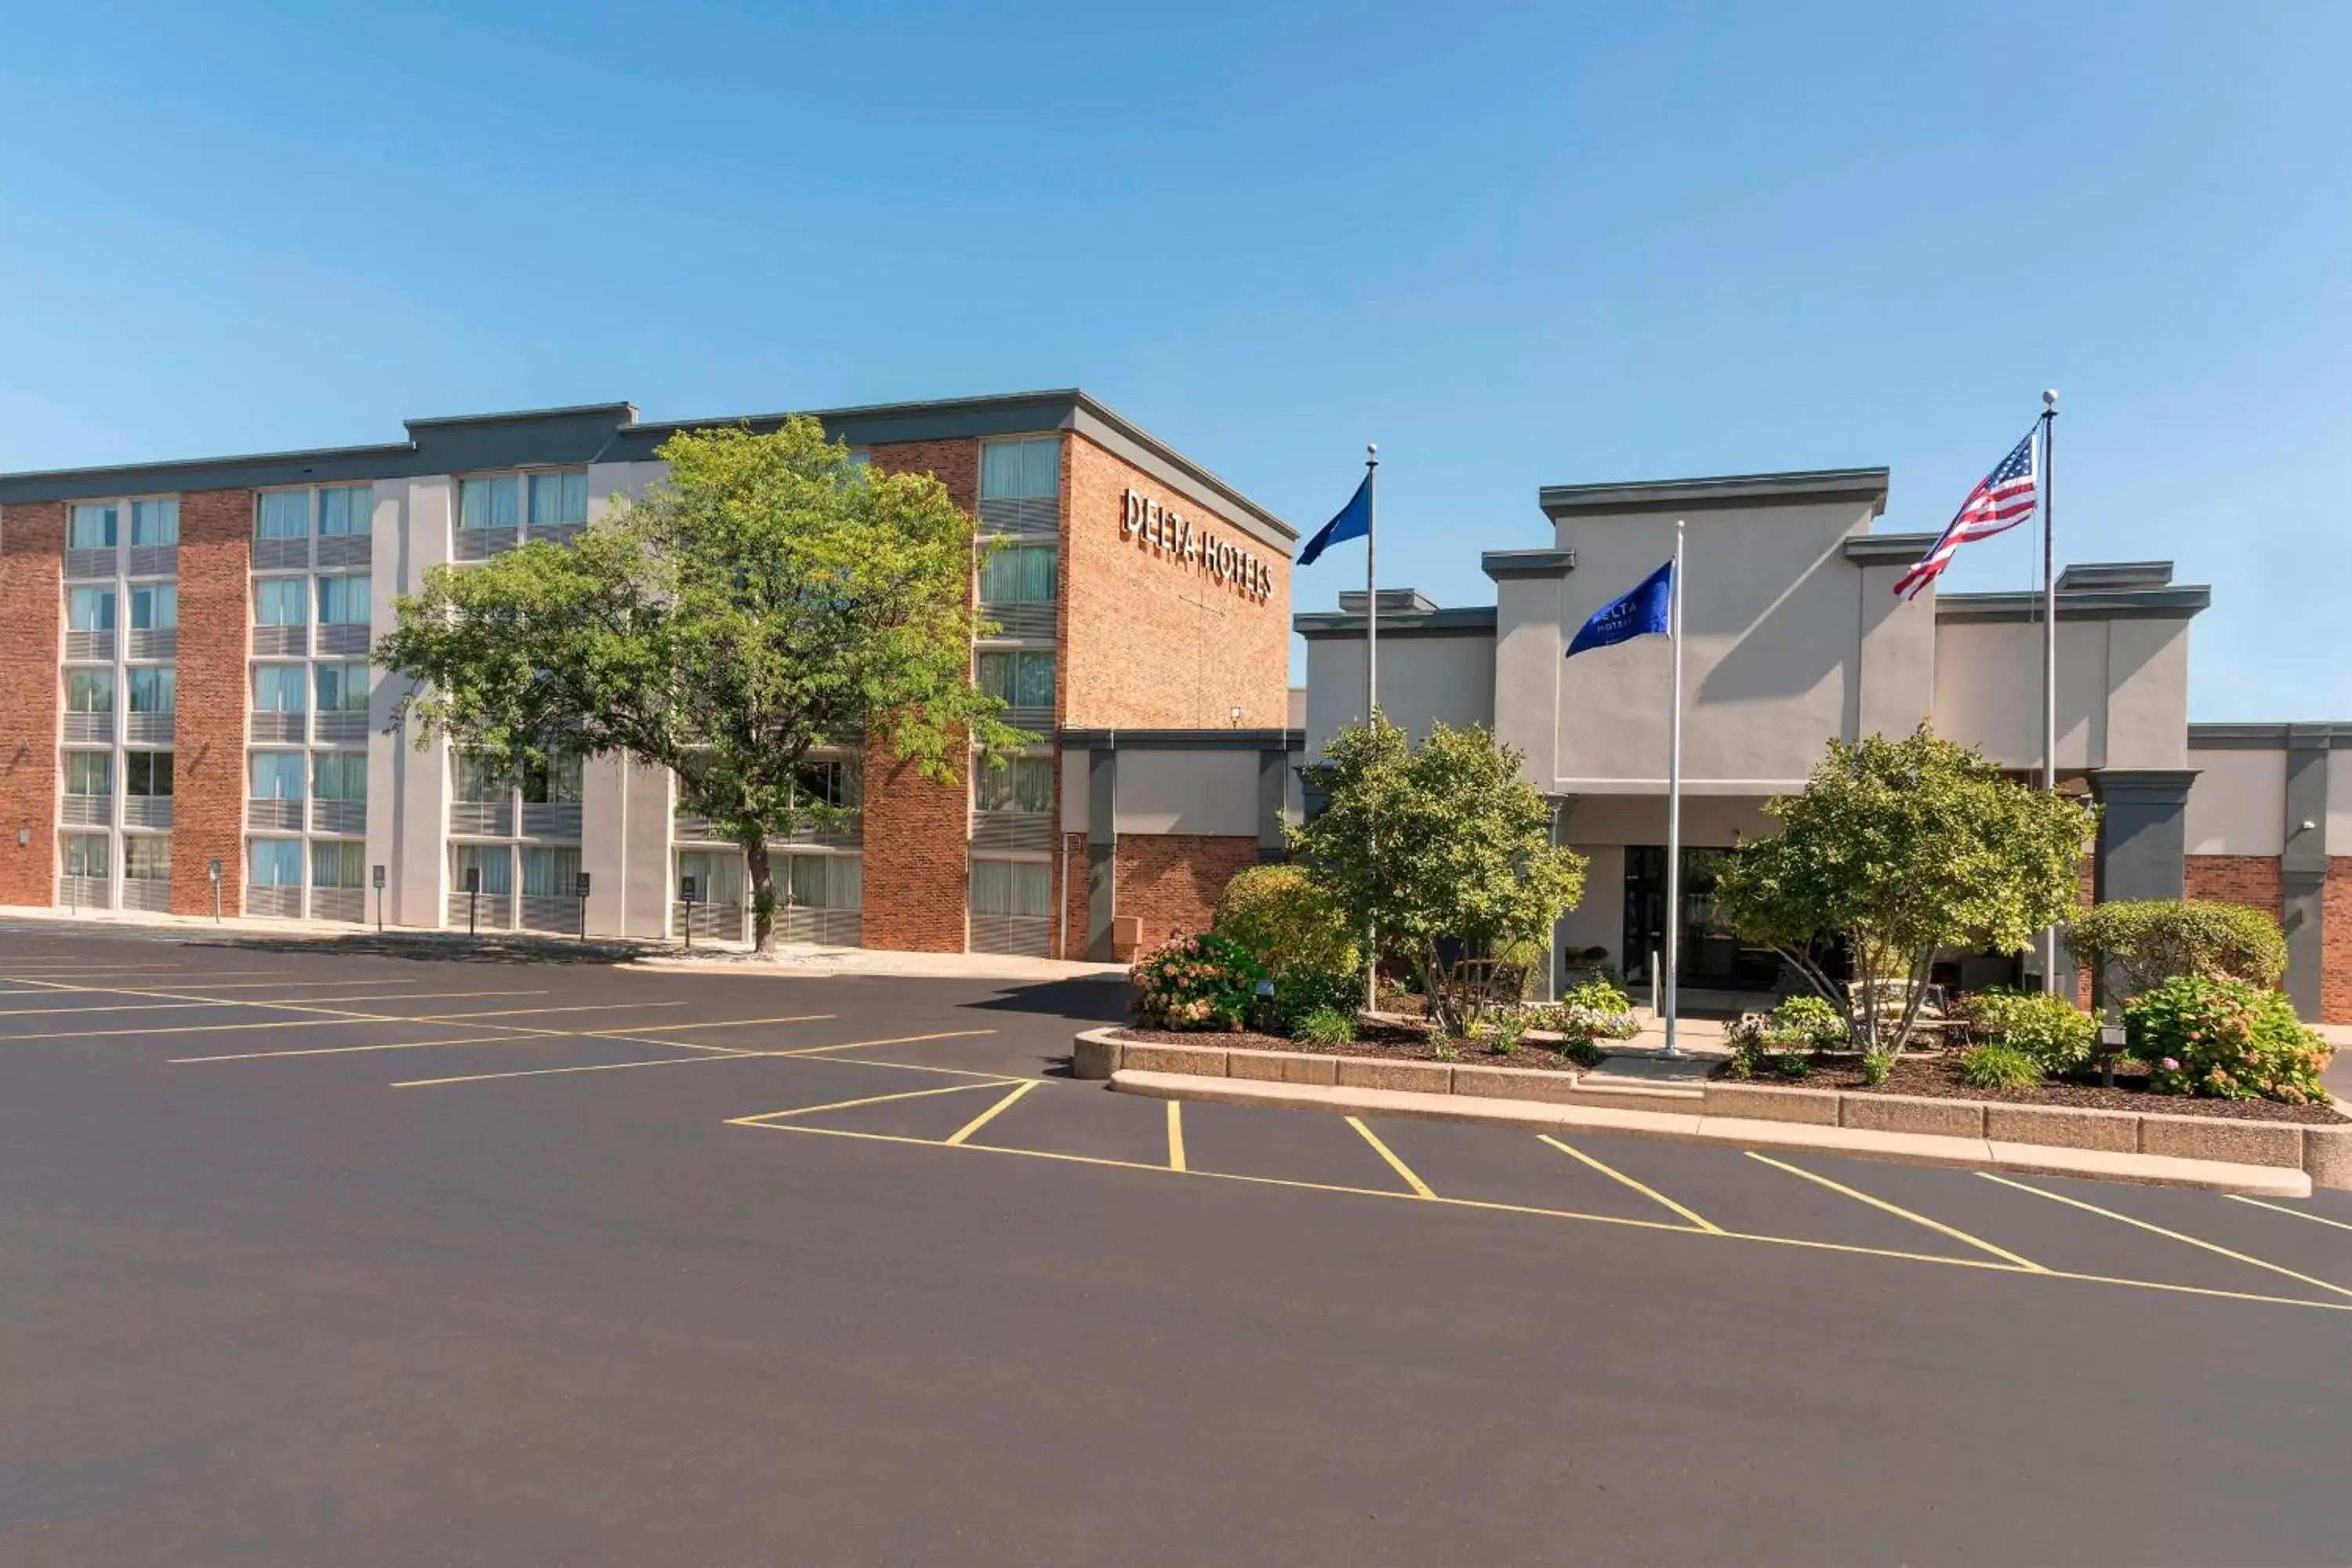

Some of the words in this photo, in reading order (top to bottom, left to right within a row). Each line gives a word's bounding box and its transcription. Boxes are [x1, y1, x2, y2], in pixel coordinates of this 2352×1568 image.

[1124, 488, 1196, 561] DELTA
[1202, 531, 1274, 599] HOTELS
[1602, 601, 1637, 620] ELTA
